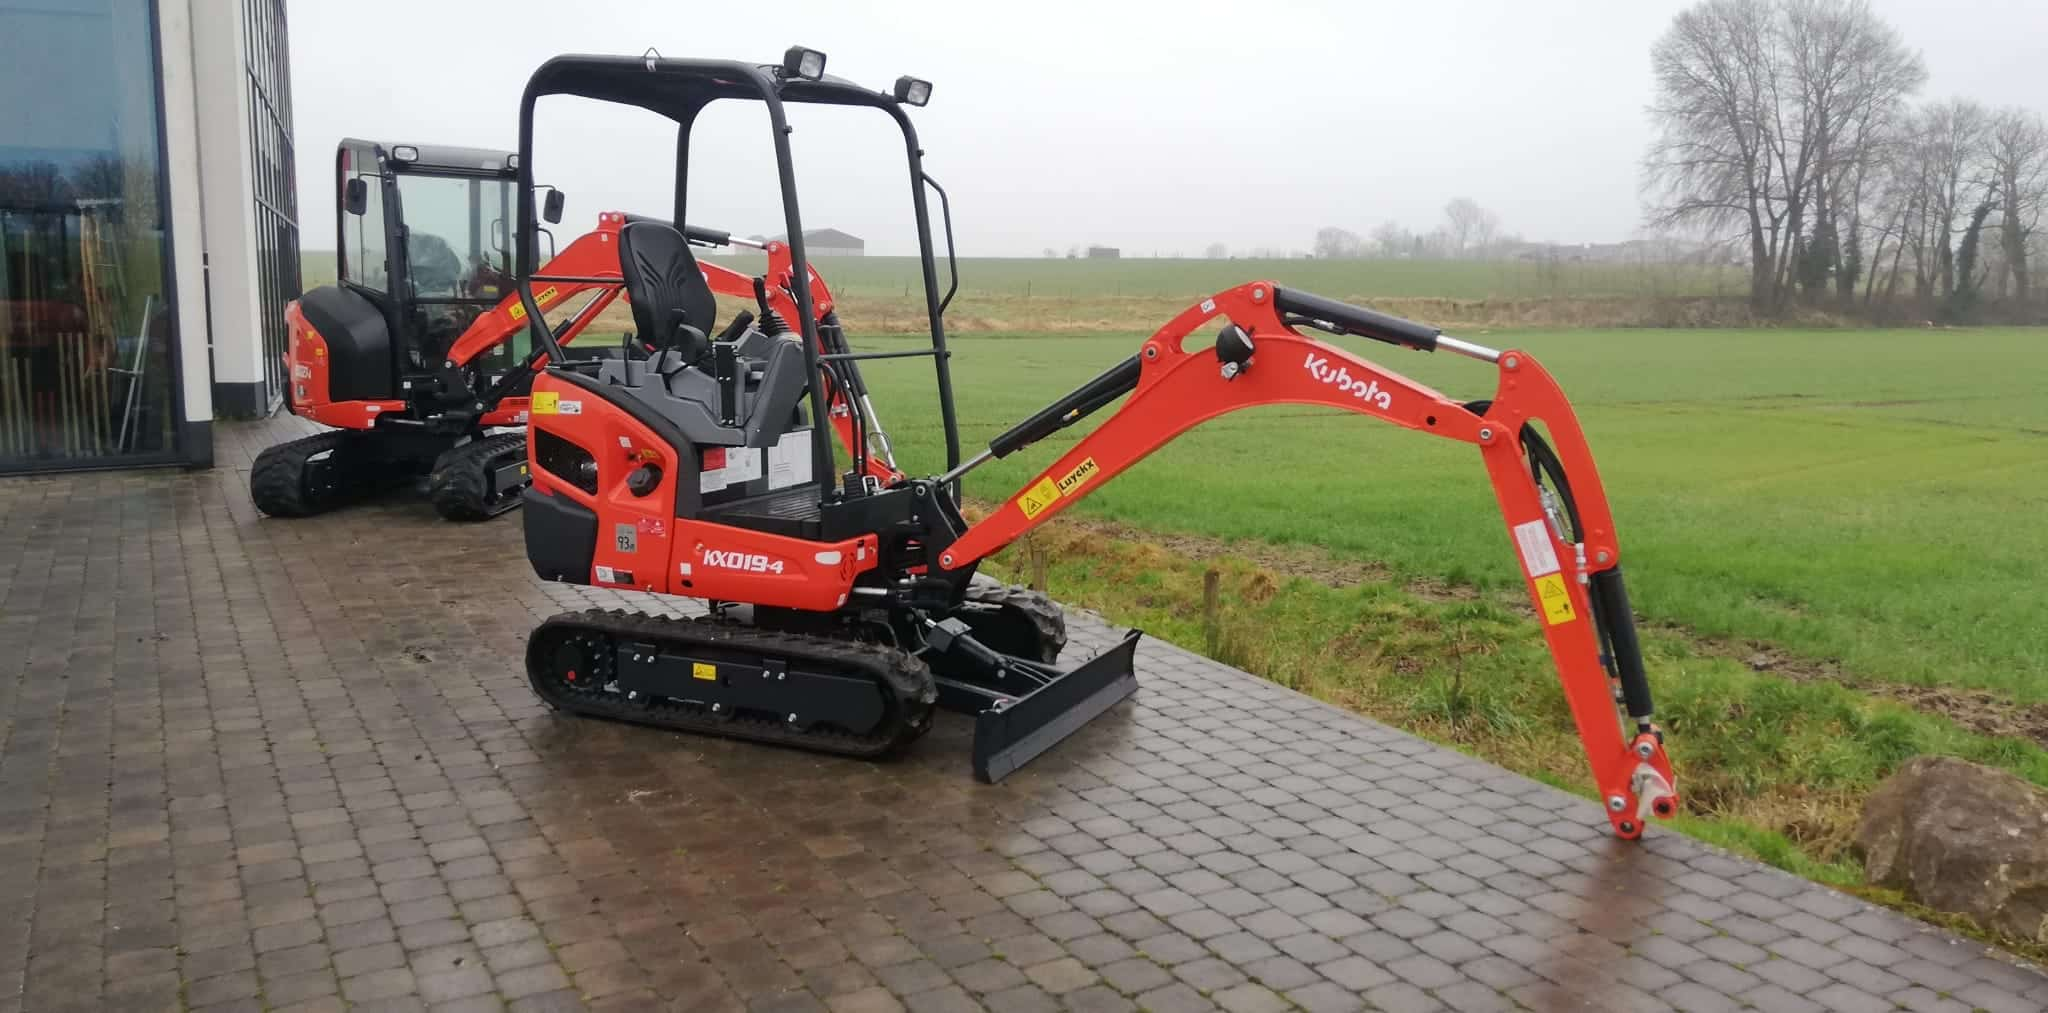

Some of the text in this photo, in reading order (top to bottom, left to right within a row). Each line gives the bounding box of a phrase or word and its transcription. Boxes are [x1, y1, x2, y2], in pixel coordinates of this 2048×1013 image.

[1304, 353, 1391, 409] Kubota
[1059, 459, 1094, 491] Luyckx
[704, 549, 784, 574] KX019-4
